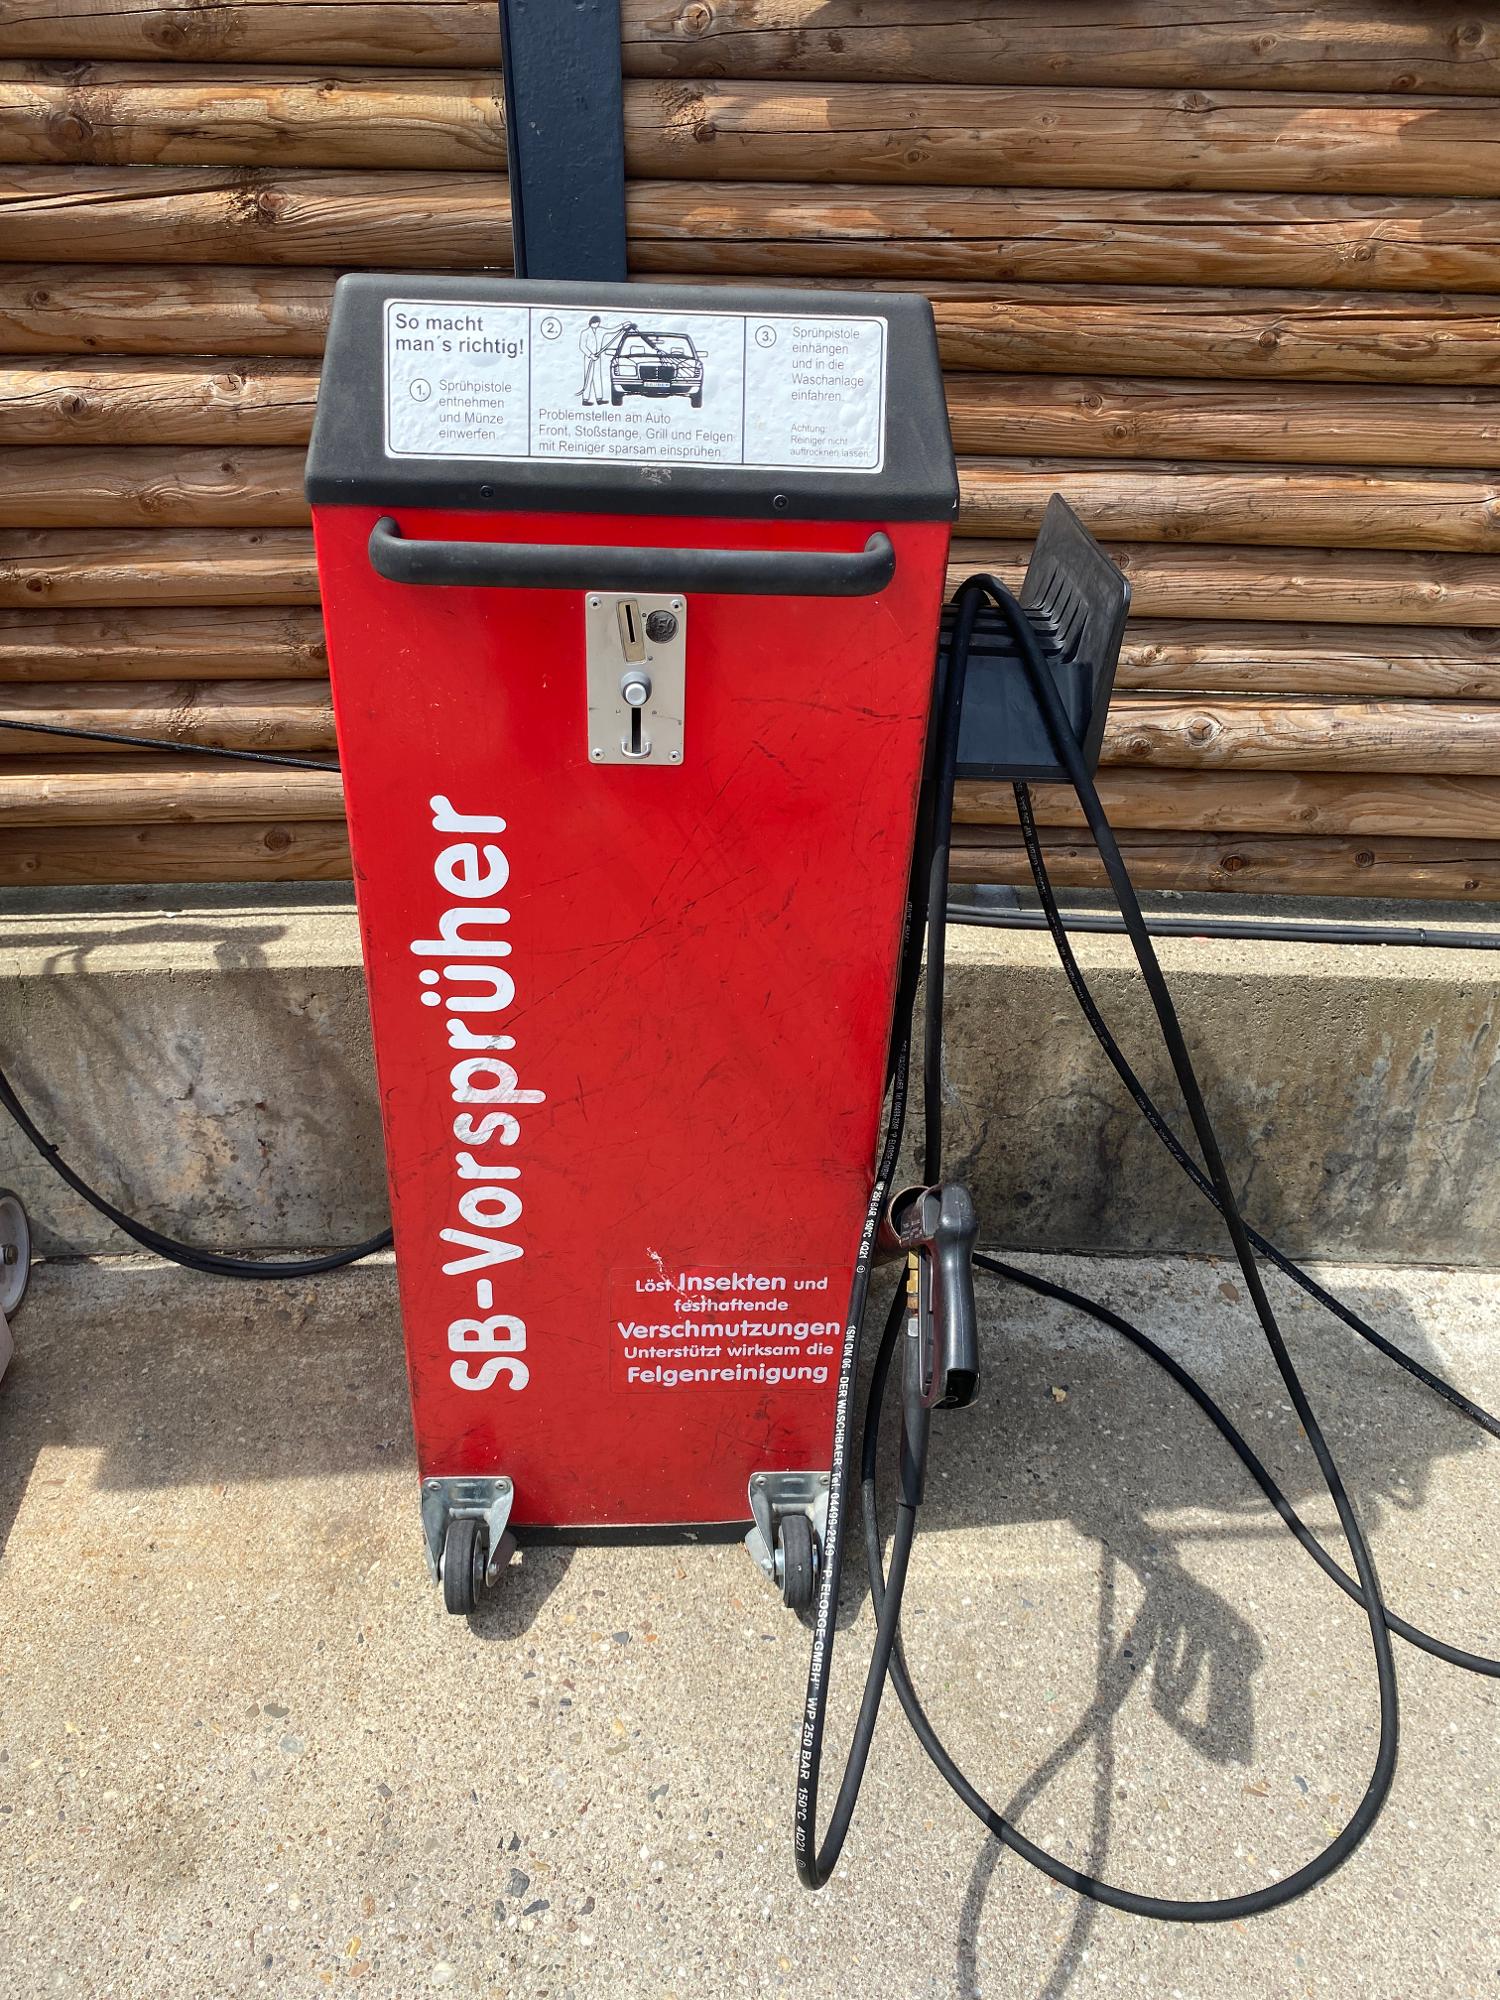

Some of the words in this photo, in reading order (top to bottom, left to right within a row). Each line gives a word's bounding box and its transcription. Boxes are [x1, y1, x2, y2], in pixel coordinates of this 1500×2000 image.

[396, 313, 419, 330] So
[426, 316, 484, 332] macht
[792, 326, 860, 340] Sprühpistole
[459, 338, 524, 358] richtig!
[792, 344, 848, 356] einhängen
[792, 358, 812, 369] und
[816, 358, 825, 369] in
[828, 359, 844, 370] die
[439, 379, 512, 394] Sprühpistole
[792, 373, 864, 388] Waschanlage
[439, 397, 505, 408] entnehmen
[439, 412, 460, 423] und
[464, 412, 504, 424] Münze
[539, 409, 621, 422] Problemstellen
[625, 413, 642, 424] am
[646, 412, 672, 424] Auto
[539, 424, 572, 438] Front,
[575, 425, 642, 441] Stoßstange,
[646, 428, 668, 440] Grill
[671, 431, 692, 440] und
[696, 430, 733, 444] Felgen
[791, 435, 826, 446] Reiniger
[828, 437, 848, 446] nicht
[539, 441, 555, 452] mit
[559, 441, 606, 455] Reiniger
[608, 444, 656, 456] sparsam
[410, 794, 546, 1392] SB-Vorsprüher
[868, 1202, 879, 1217] BAR
[635, 1279, 671, 1292] Löst
[679, 1272, 786, 1292] Insekten
[794, 1277, 828, 1290] und
[674, 1298, 789, 1312] festhaftende
[618, 1320, 840, 1340] Verschmutzungen
[845, 1324, 856, 1341] 1SN
[624, 1344, 721, 1359] Unterstützt
[727, 1344, 800, 1357] wirksam
[806, 1342, 834, 1355] die
[843, 1344, 854, 1356] DN
[842, 1358, 852, 1369] 06
[627, 1363, 828, 1386] Felgenreinigung
[838, 1377, 849, 1397] DER
[833, 1399, 847, 1466] WASCHBAER
[831, 1471, 841, 1490] Tel.
[824, 1492, 839, 1556] 04499-2249
[815, 1583, 831, 1638] ELOSGE
[807, 1697, 818, 1720] WP
[802, 1723, 817, 1747] 250
[800, 1750, 812, 1780] BAR
[797, 1786, 809, 1821] 150°C
